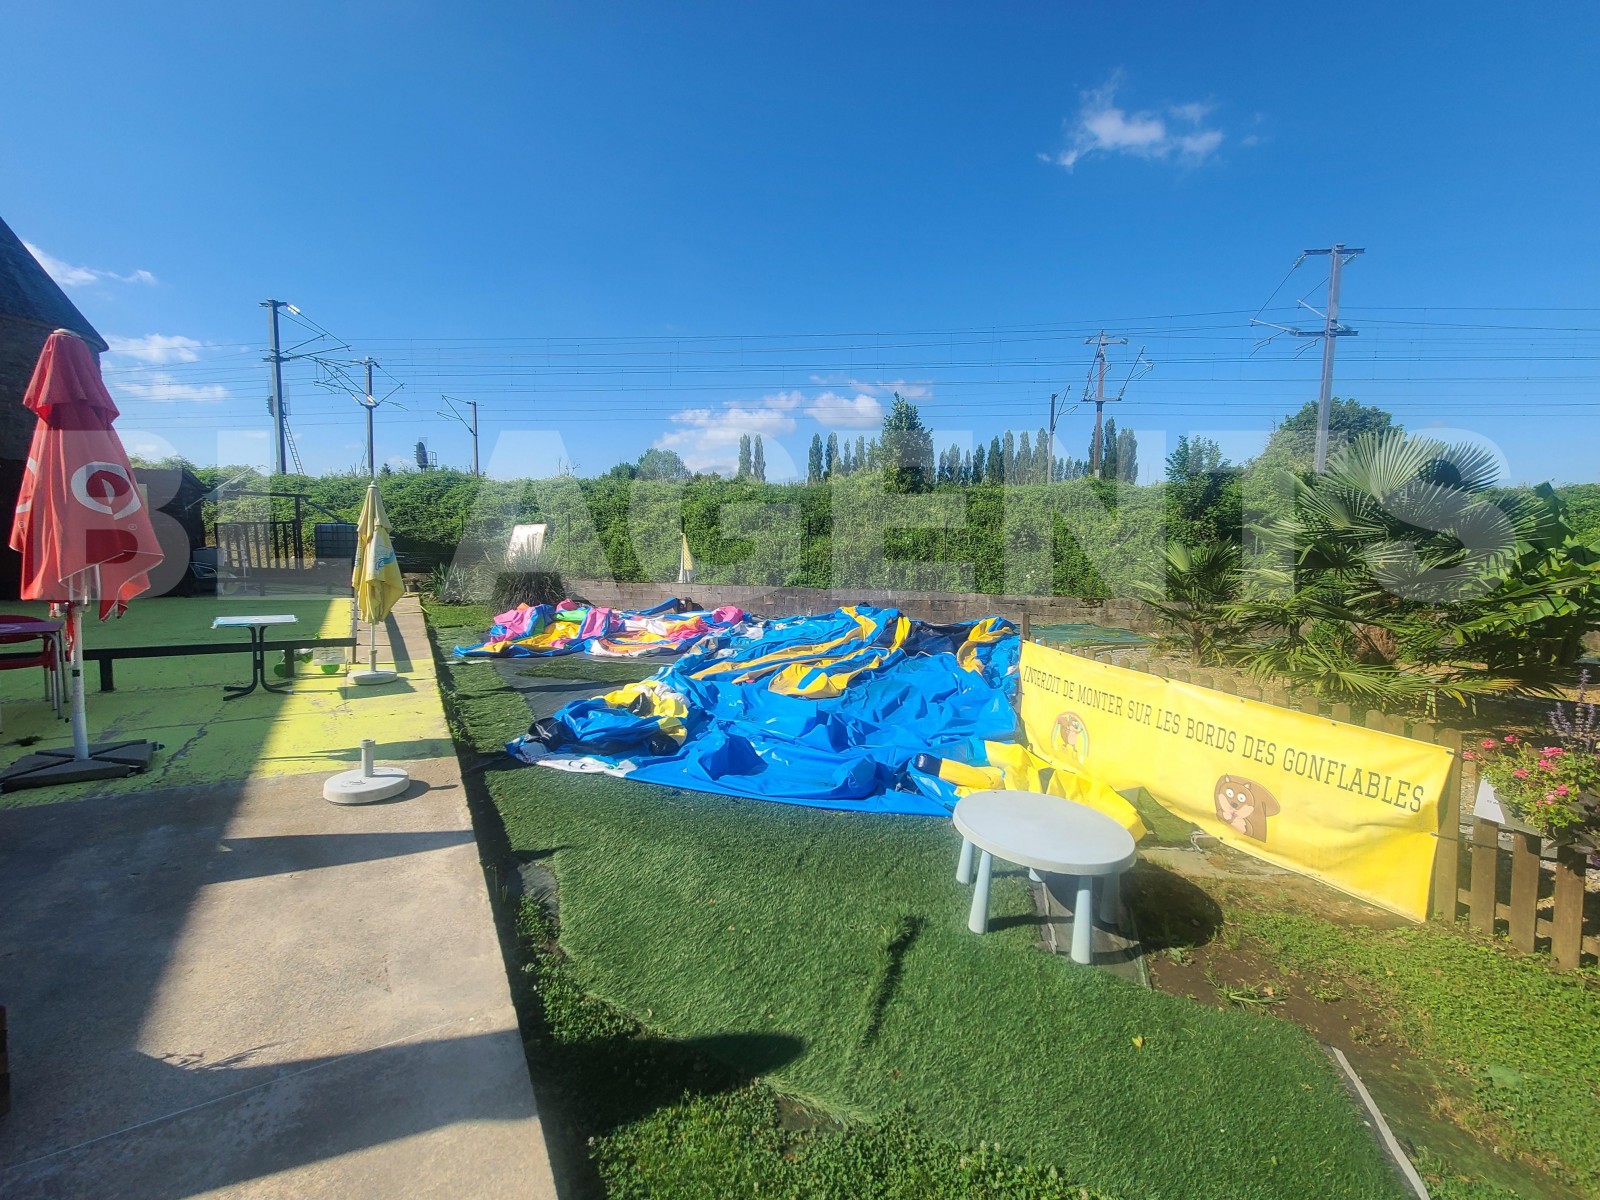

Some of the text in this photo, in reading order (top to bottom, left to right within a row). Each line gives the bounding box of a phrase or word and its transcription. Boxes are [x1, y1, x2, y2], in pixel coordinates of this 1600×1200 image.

[1023, 666, 1424, 812] INTERDIT DE MONTER SUR LES BORDS DES GONFLABLES
